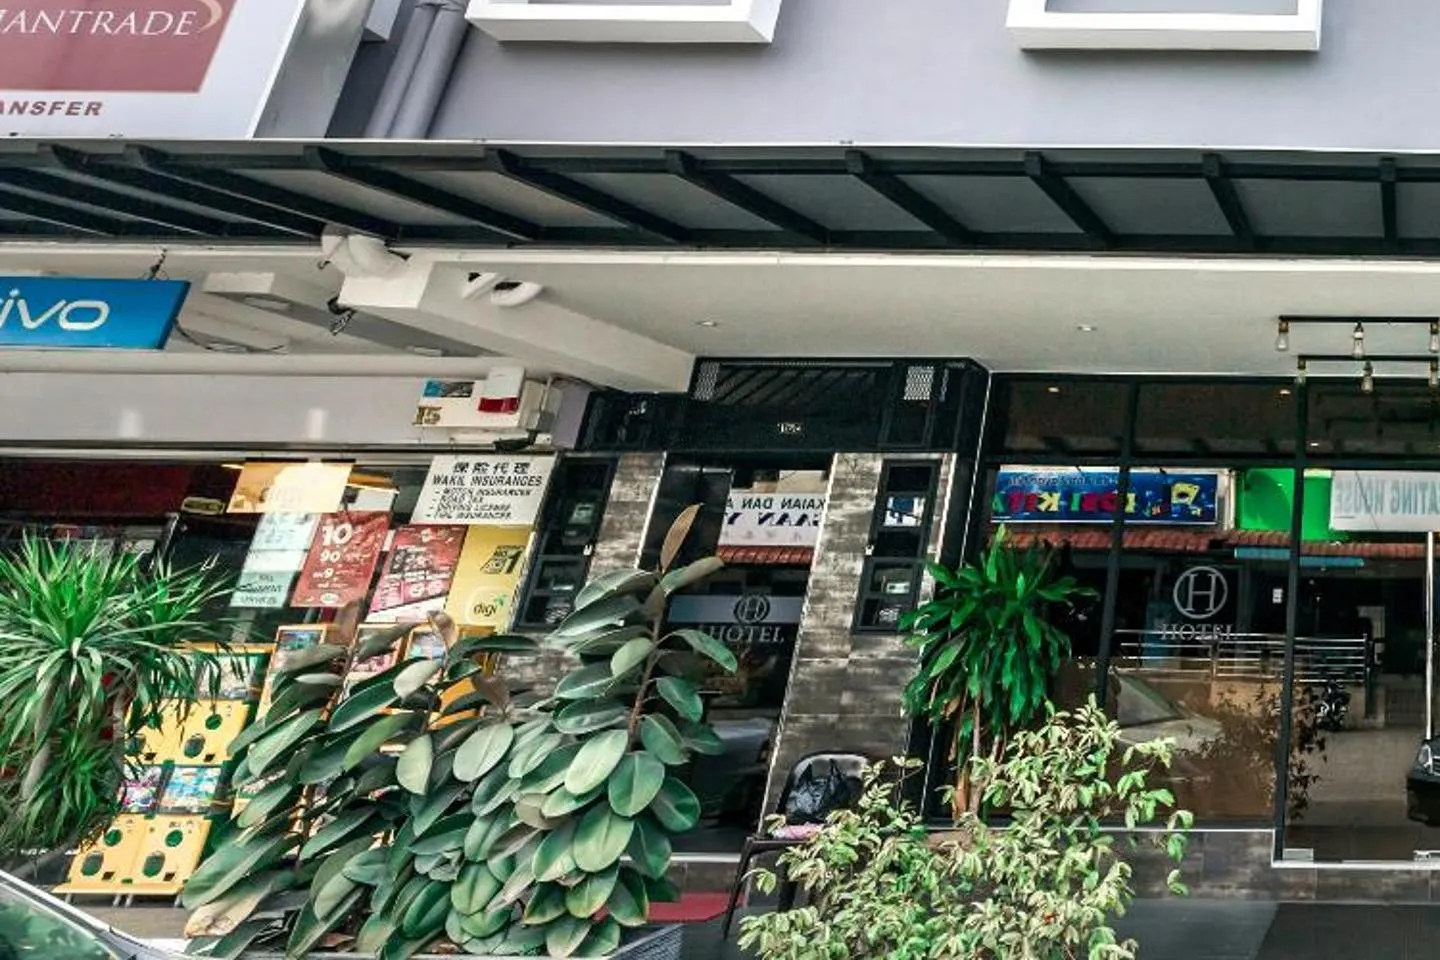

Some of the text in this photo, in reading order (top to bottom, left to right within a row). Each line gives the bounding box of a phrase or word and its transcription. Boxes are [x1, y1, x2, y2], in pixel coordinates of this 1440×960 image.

[412, 406, 442, 425] 15
[433, 474, 465, 486] WAKIL
[473, 603, 497, 617] digi
